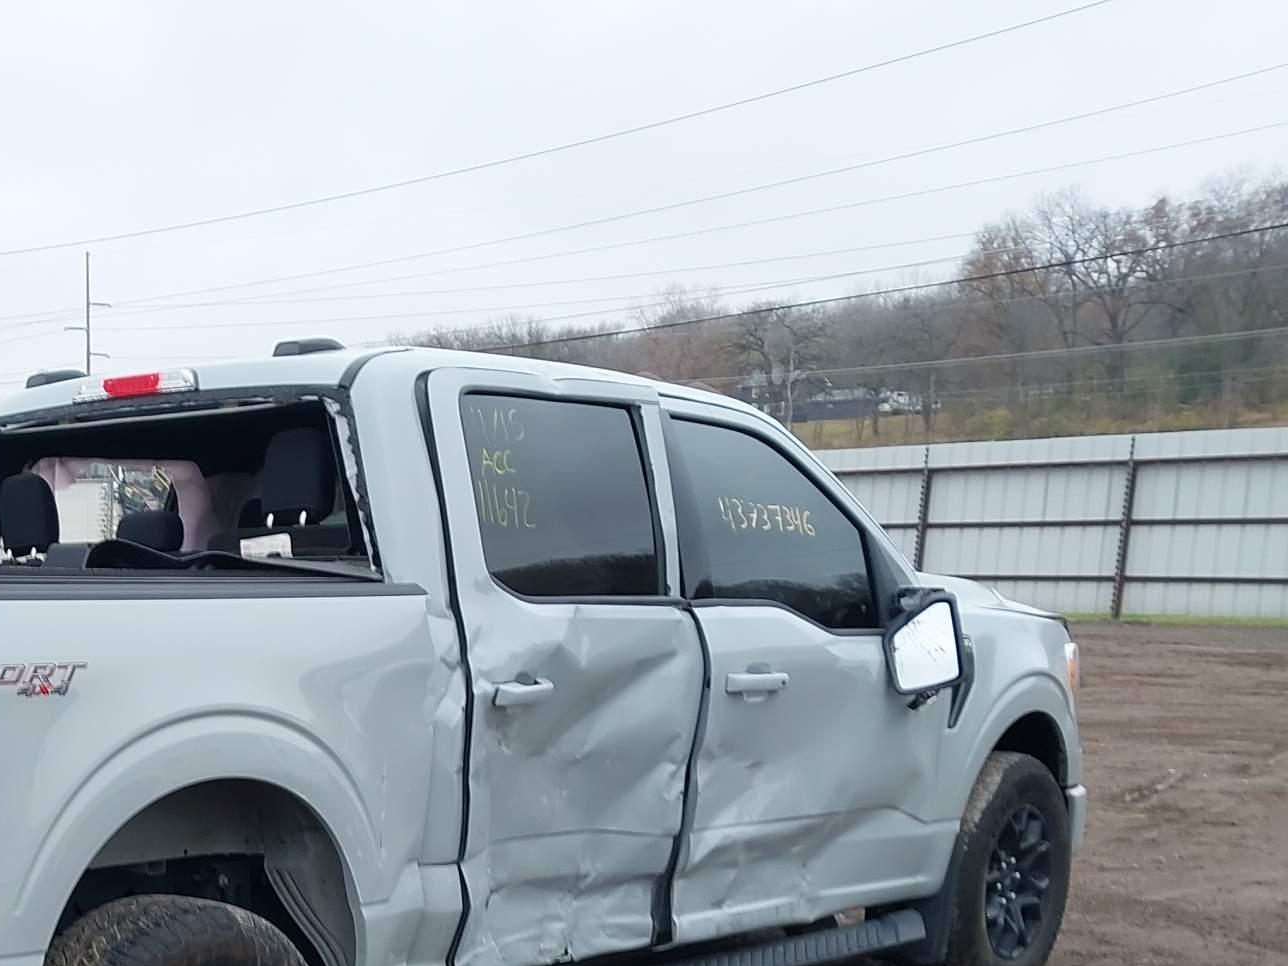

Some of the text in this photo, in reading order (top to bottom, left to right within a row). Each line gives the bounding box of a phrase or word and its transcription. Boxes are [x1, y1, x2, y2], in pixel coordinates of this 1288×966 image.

[480, 447, 517, 476] ACC
[477, 479, 537, 529] 11642
[717, 496, 816, 537] 43737346
